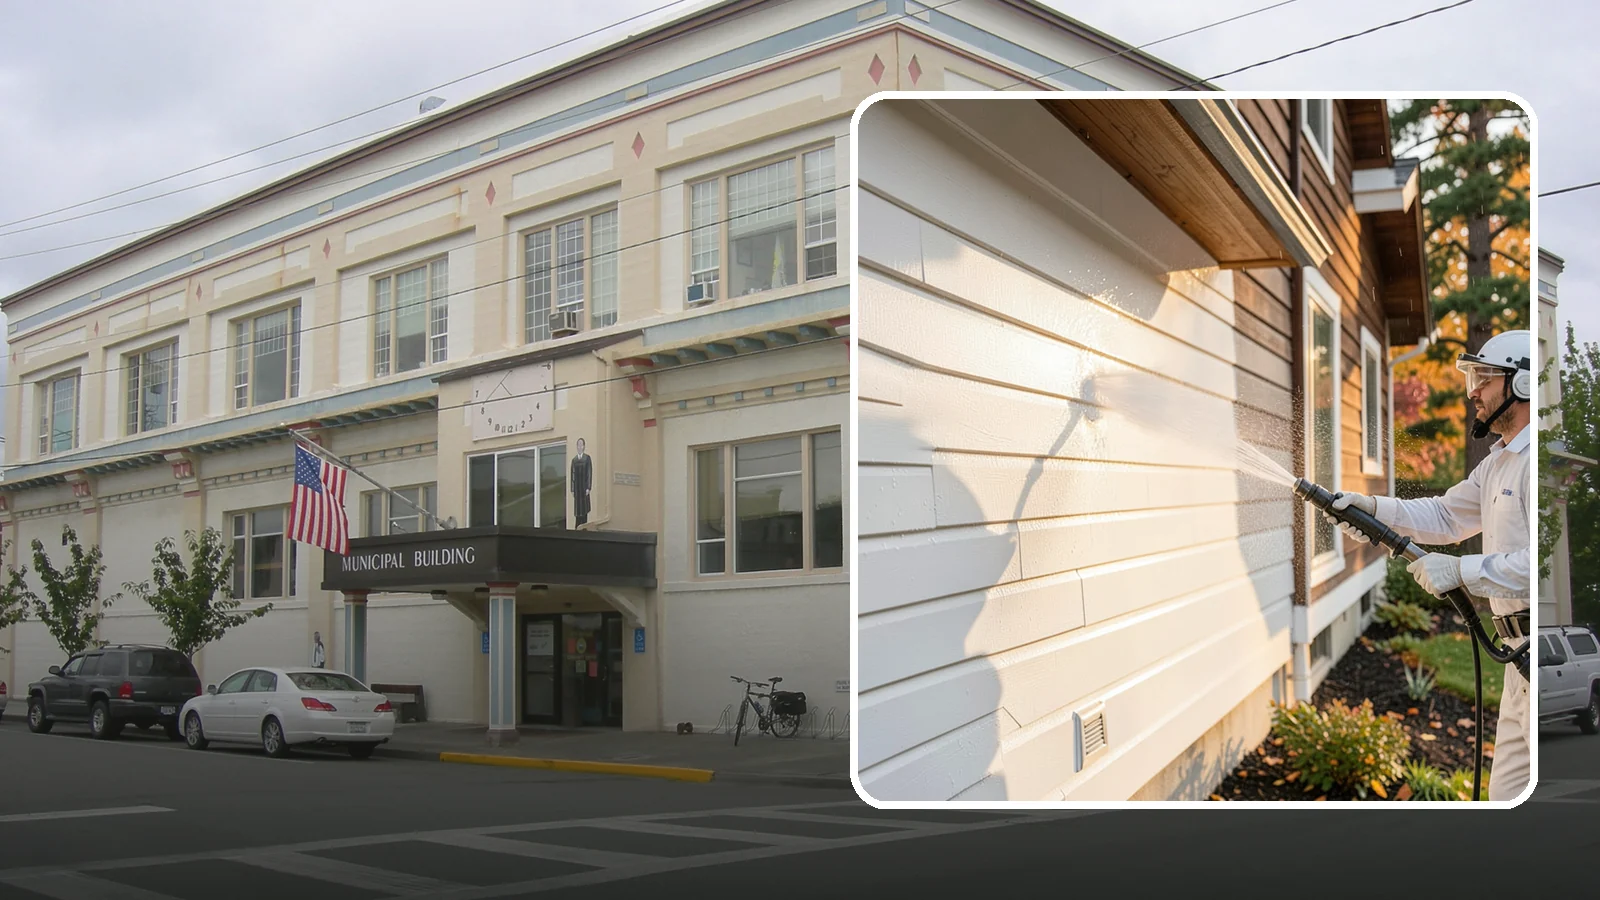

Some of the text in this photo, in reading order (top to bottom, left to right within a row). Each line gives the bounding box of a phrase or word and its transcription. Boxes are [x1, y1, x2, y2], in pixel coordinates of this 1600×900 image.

[536, 402, 540, 410] 4
[481, 407, 485, 415] 8
[488, 418, 492, 426] 9
[529, 414, 533, 422] 3
[495, 423, 500, 432] 10
[521, 420, 525, 428] 2
[501, 425, 506, 433] 11
[507, 425, 513, 433] 12
[342, 546, 476, 572] MUNICIPAL BUILDING
